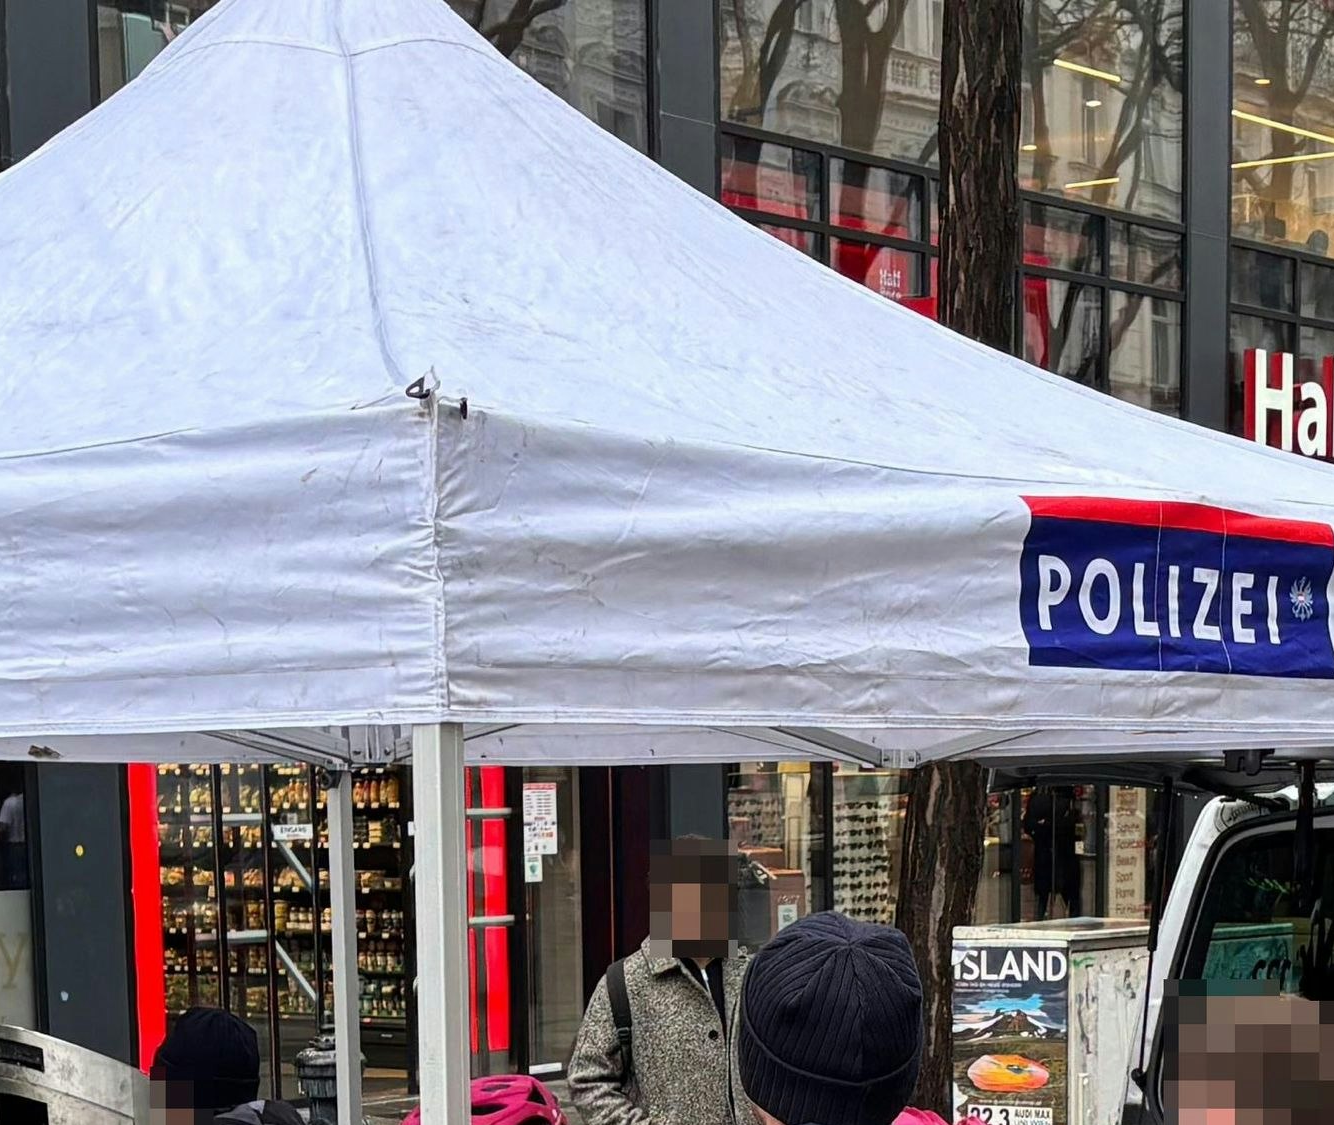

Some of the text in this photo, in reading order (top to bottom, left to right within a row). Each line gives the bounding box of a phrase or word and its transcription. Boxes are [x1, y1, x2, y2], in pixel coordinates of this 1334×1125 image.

[1037, 554, 1281, 645] POLIZEI
[1014, 1109, 1032, 1119] AUDI
[1034, 1109, 1051, 1119] MAX
